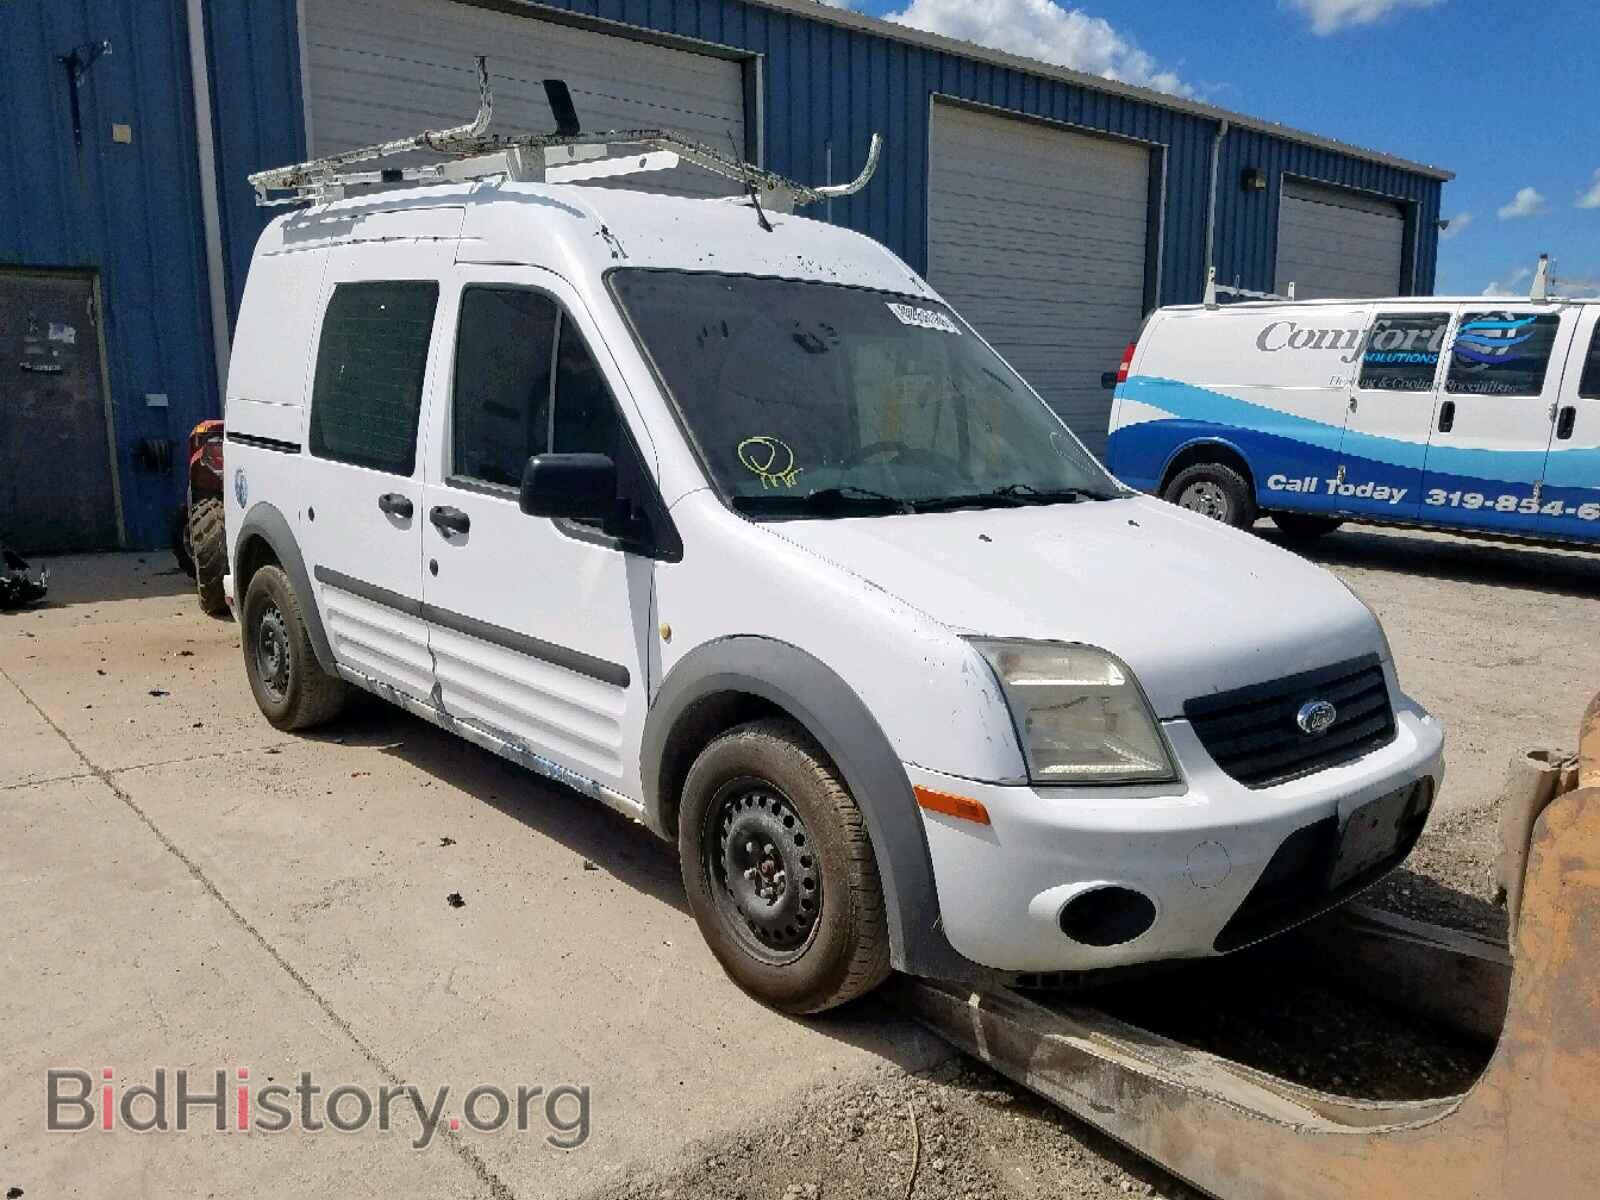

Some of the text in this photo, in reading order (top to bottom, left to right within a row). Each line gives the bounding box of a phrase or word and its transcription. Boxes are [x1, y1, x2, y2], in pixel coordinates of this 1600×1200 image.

[1256, 320, 1447, 363] Comfort
[1360, 352, 1438, 365] SOLUTIONS
[1267, 474, 1600, 521] Call Today 319-854-6
